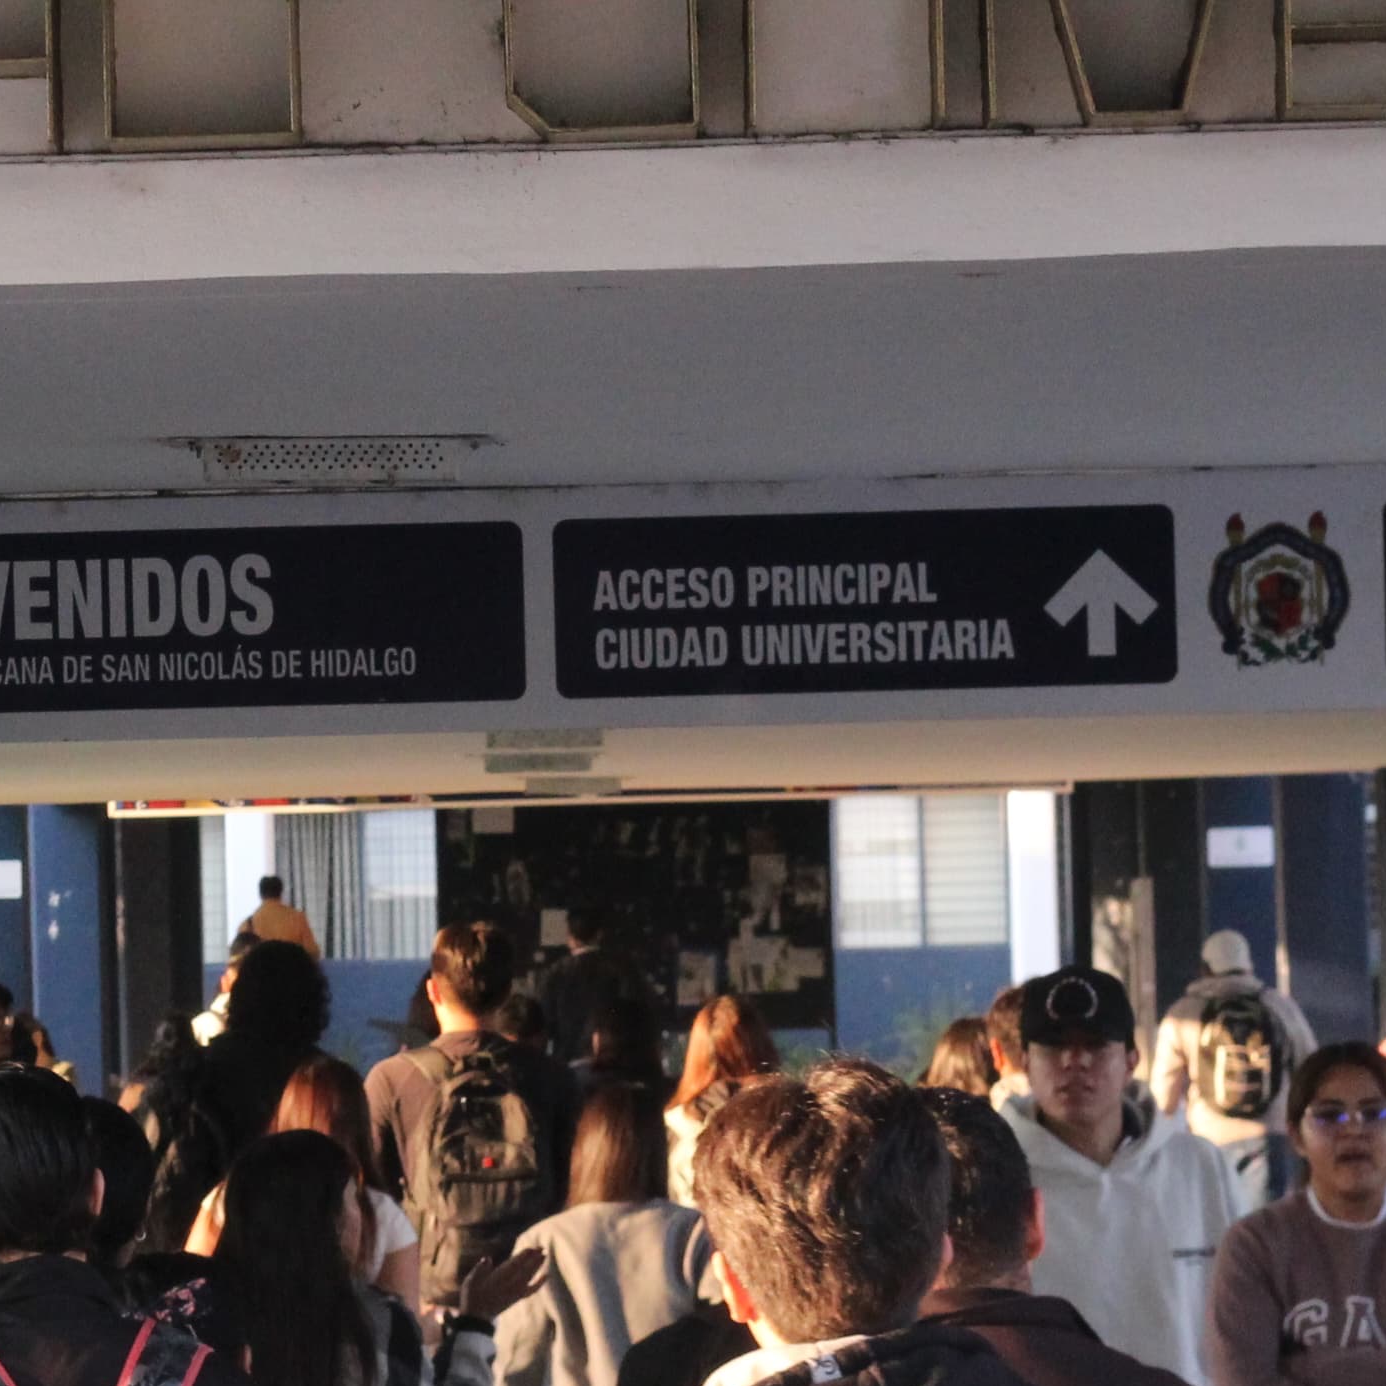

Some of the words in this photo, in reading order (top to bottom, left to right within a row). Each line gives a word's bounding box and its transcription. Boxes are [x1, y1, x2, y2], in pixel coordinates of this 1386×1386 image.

[594, 567, 735, 611] ACCESO
[748, 562, 938, 607] PRINCIPAL
[62, 654, 94, 684] DE
[101, 653, 151, 683] SAN
[158, 645, 263, 682] NICOLÁS
[271, 649, 303, 679] DE
[310, 646, 417, 678] HIDALGO
[595, 626, 729, 670] CIUDAD
[741, 618, 1015, 666] UNIVERSITARIA
